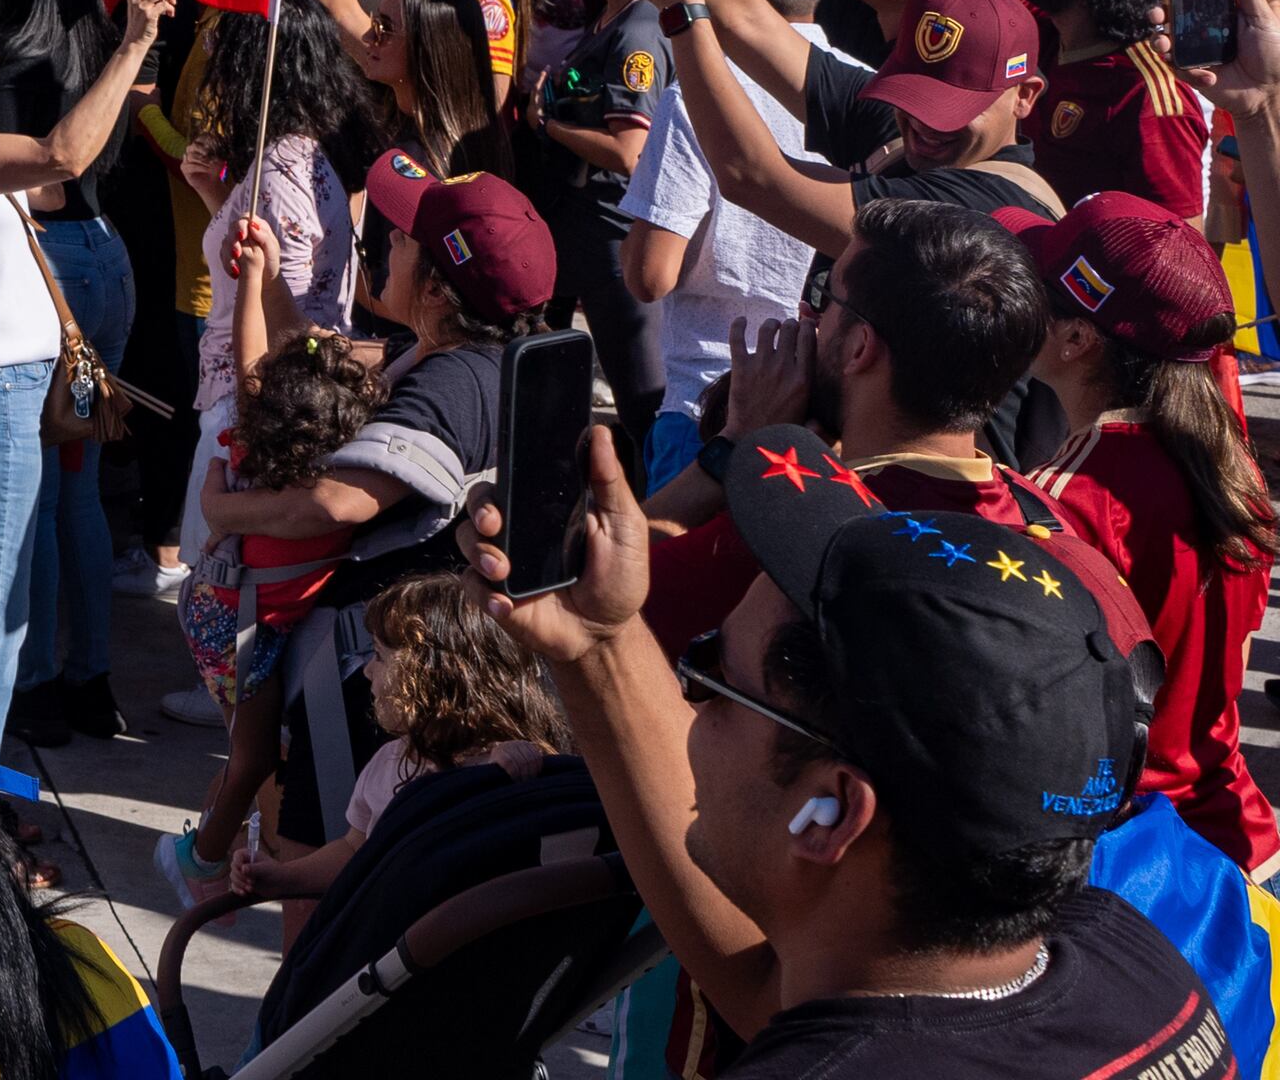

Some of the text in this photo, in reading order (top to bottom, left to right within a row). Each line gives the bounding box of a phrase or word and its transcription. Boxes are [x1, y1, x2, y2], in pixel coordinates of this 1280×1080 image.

[1098, 758, 1115, 776] TE
[1081, 776, 1117, 796] AMO
[1176, 1034, 1215, 1080] END
